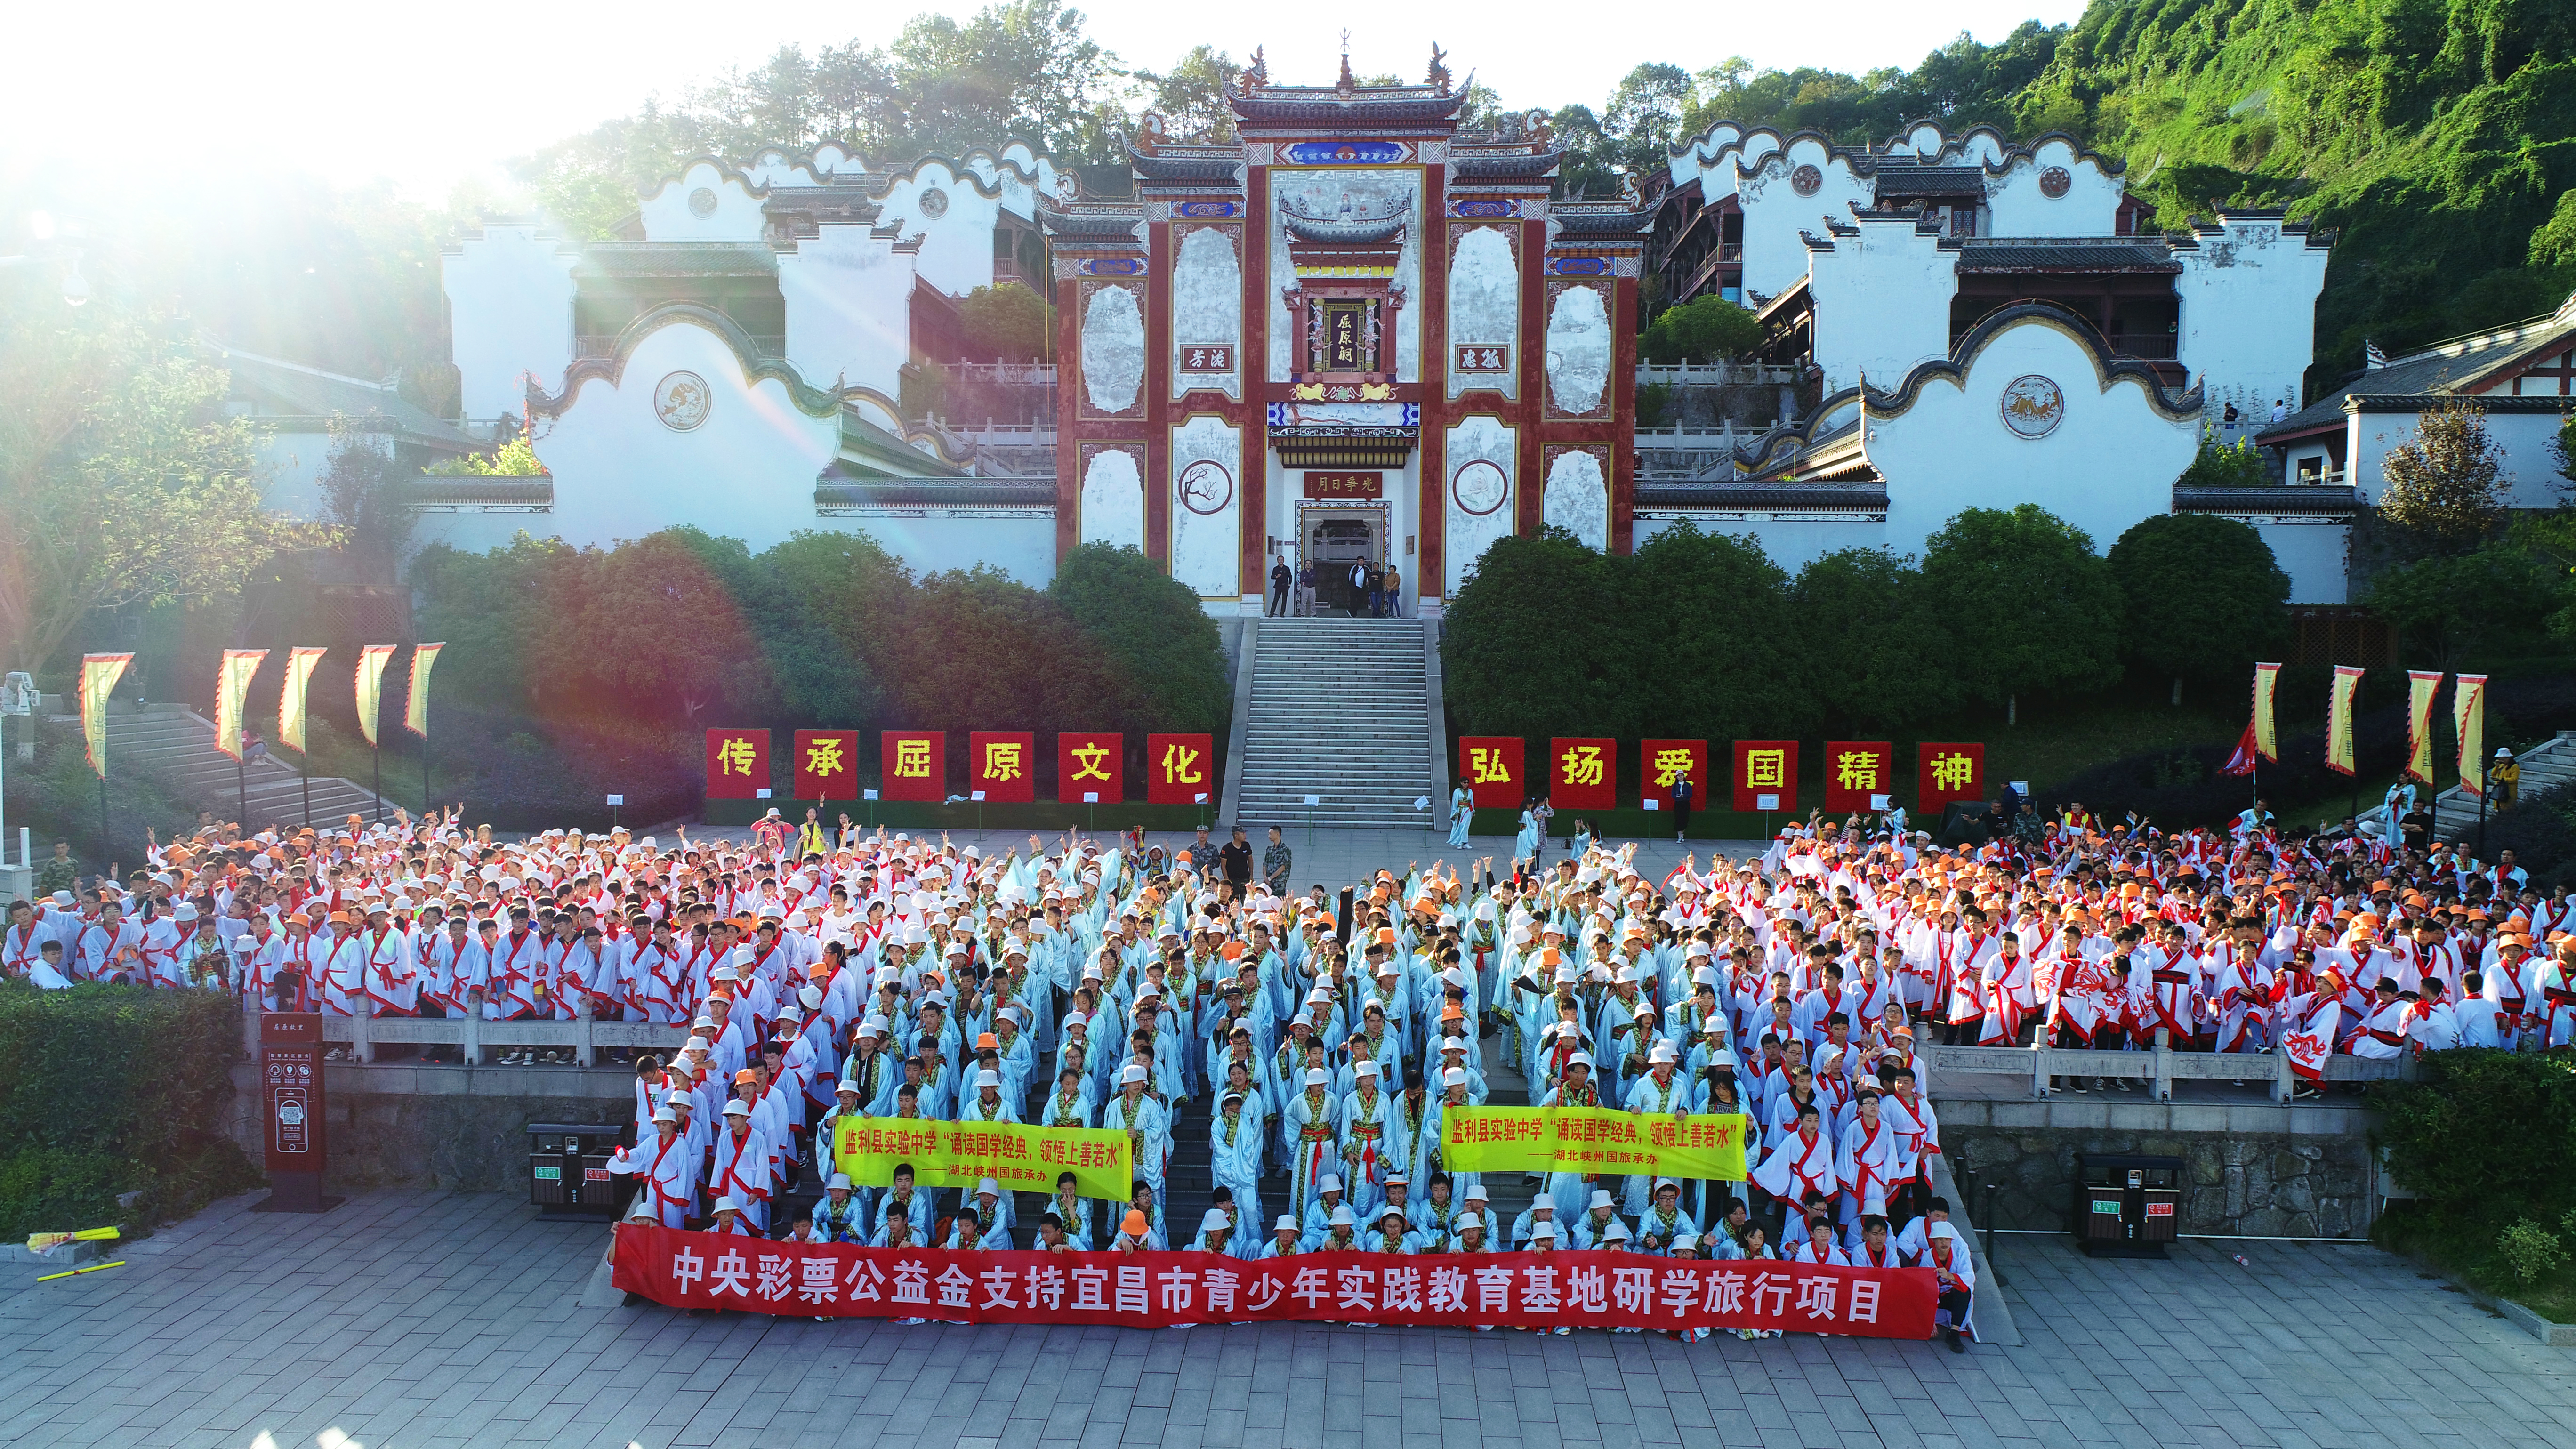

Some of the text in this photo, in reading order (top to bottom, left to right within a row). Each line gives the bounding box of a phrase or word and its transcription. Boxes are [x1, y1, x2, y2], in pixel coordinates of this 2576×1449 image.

[1337, 314, 1352, 362] 屈原祠
[673, 1246, 1883, 1324] 中央彩票公益金支持宜昌市青少年实践教育基地研学旅行项目
